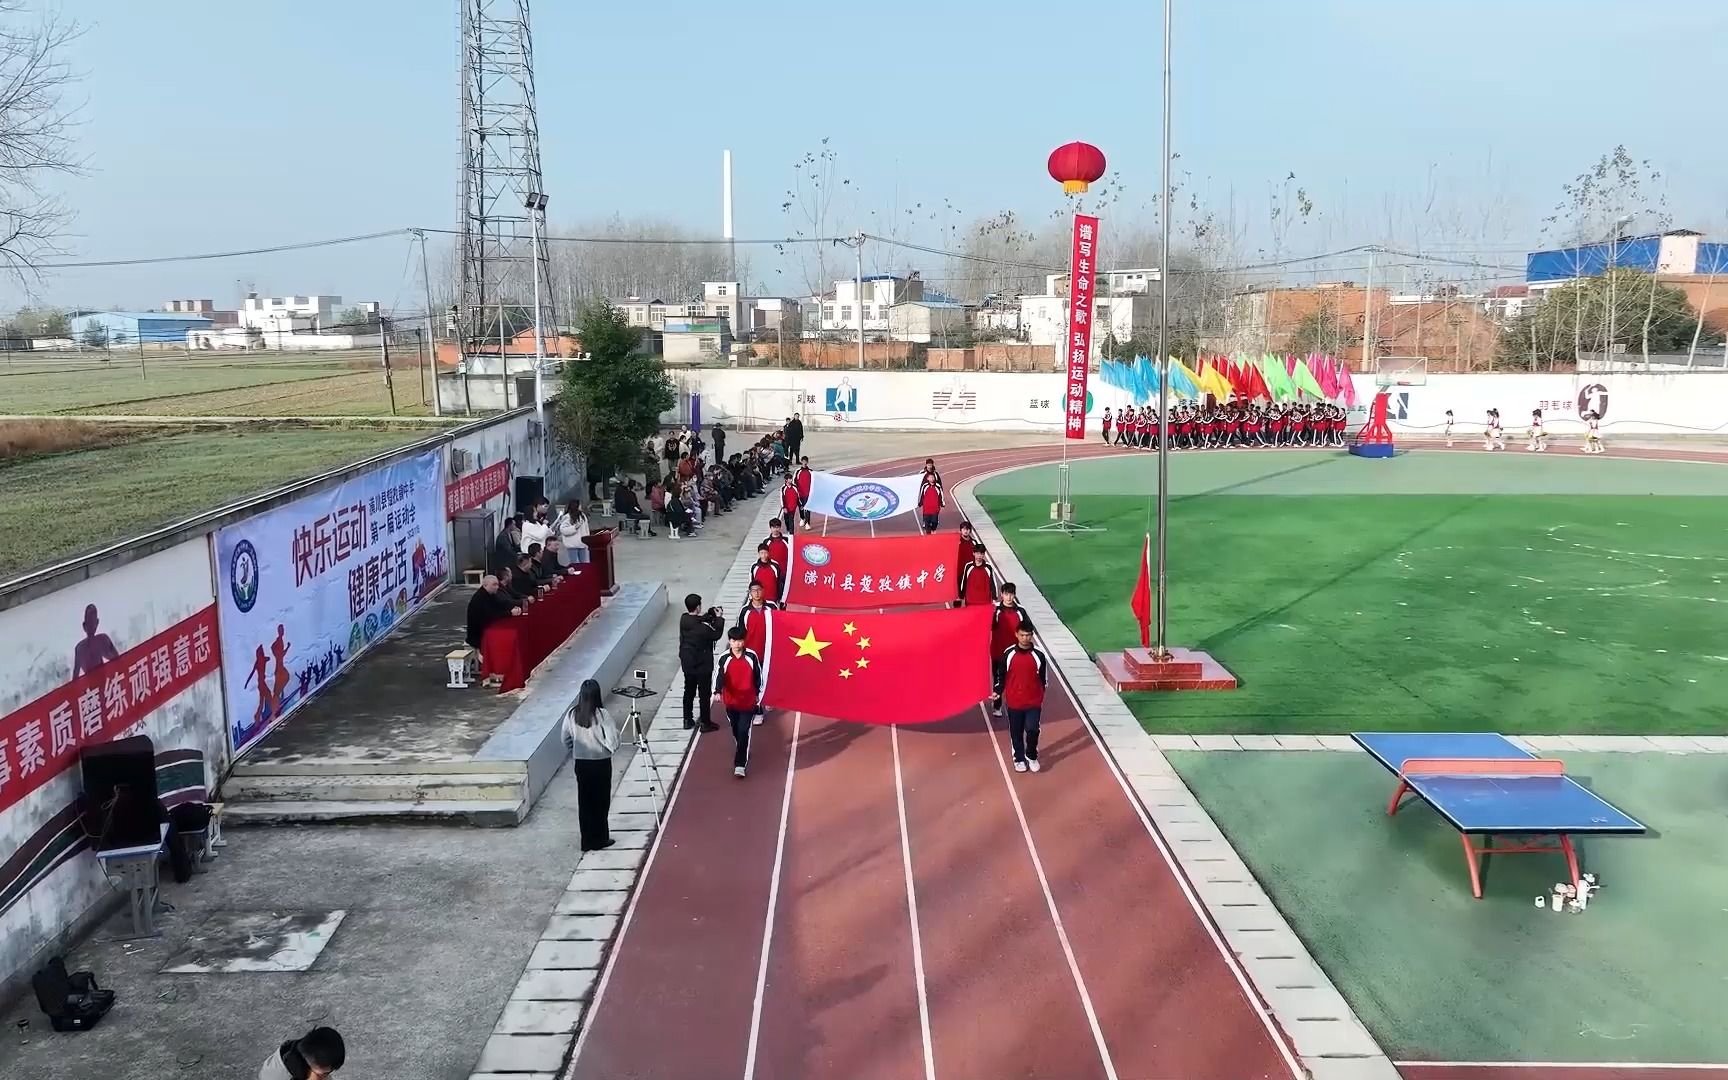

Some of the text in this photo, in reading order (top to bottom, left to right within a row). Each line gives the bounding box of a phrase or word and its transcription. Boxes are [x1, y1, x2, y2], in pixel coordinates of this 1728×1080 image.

[1067, 224, 1093, 432] 谱写生命之歌 弘扬运动精神
[1030, 399, 1050, 409] 篮球
[1539, 400, 1572, 411] 羽毛球
[292, 500, 367, 588] 快乐运动
[370, 502, 416, 546] 第一届运动会
[347, 537, 408, 621] 健康生活
